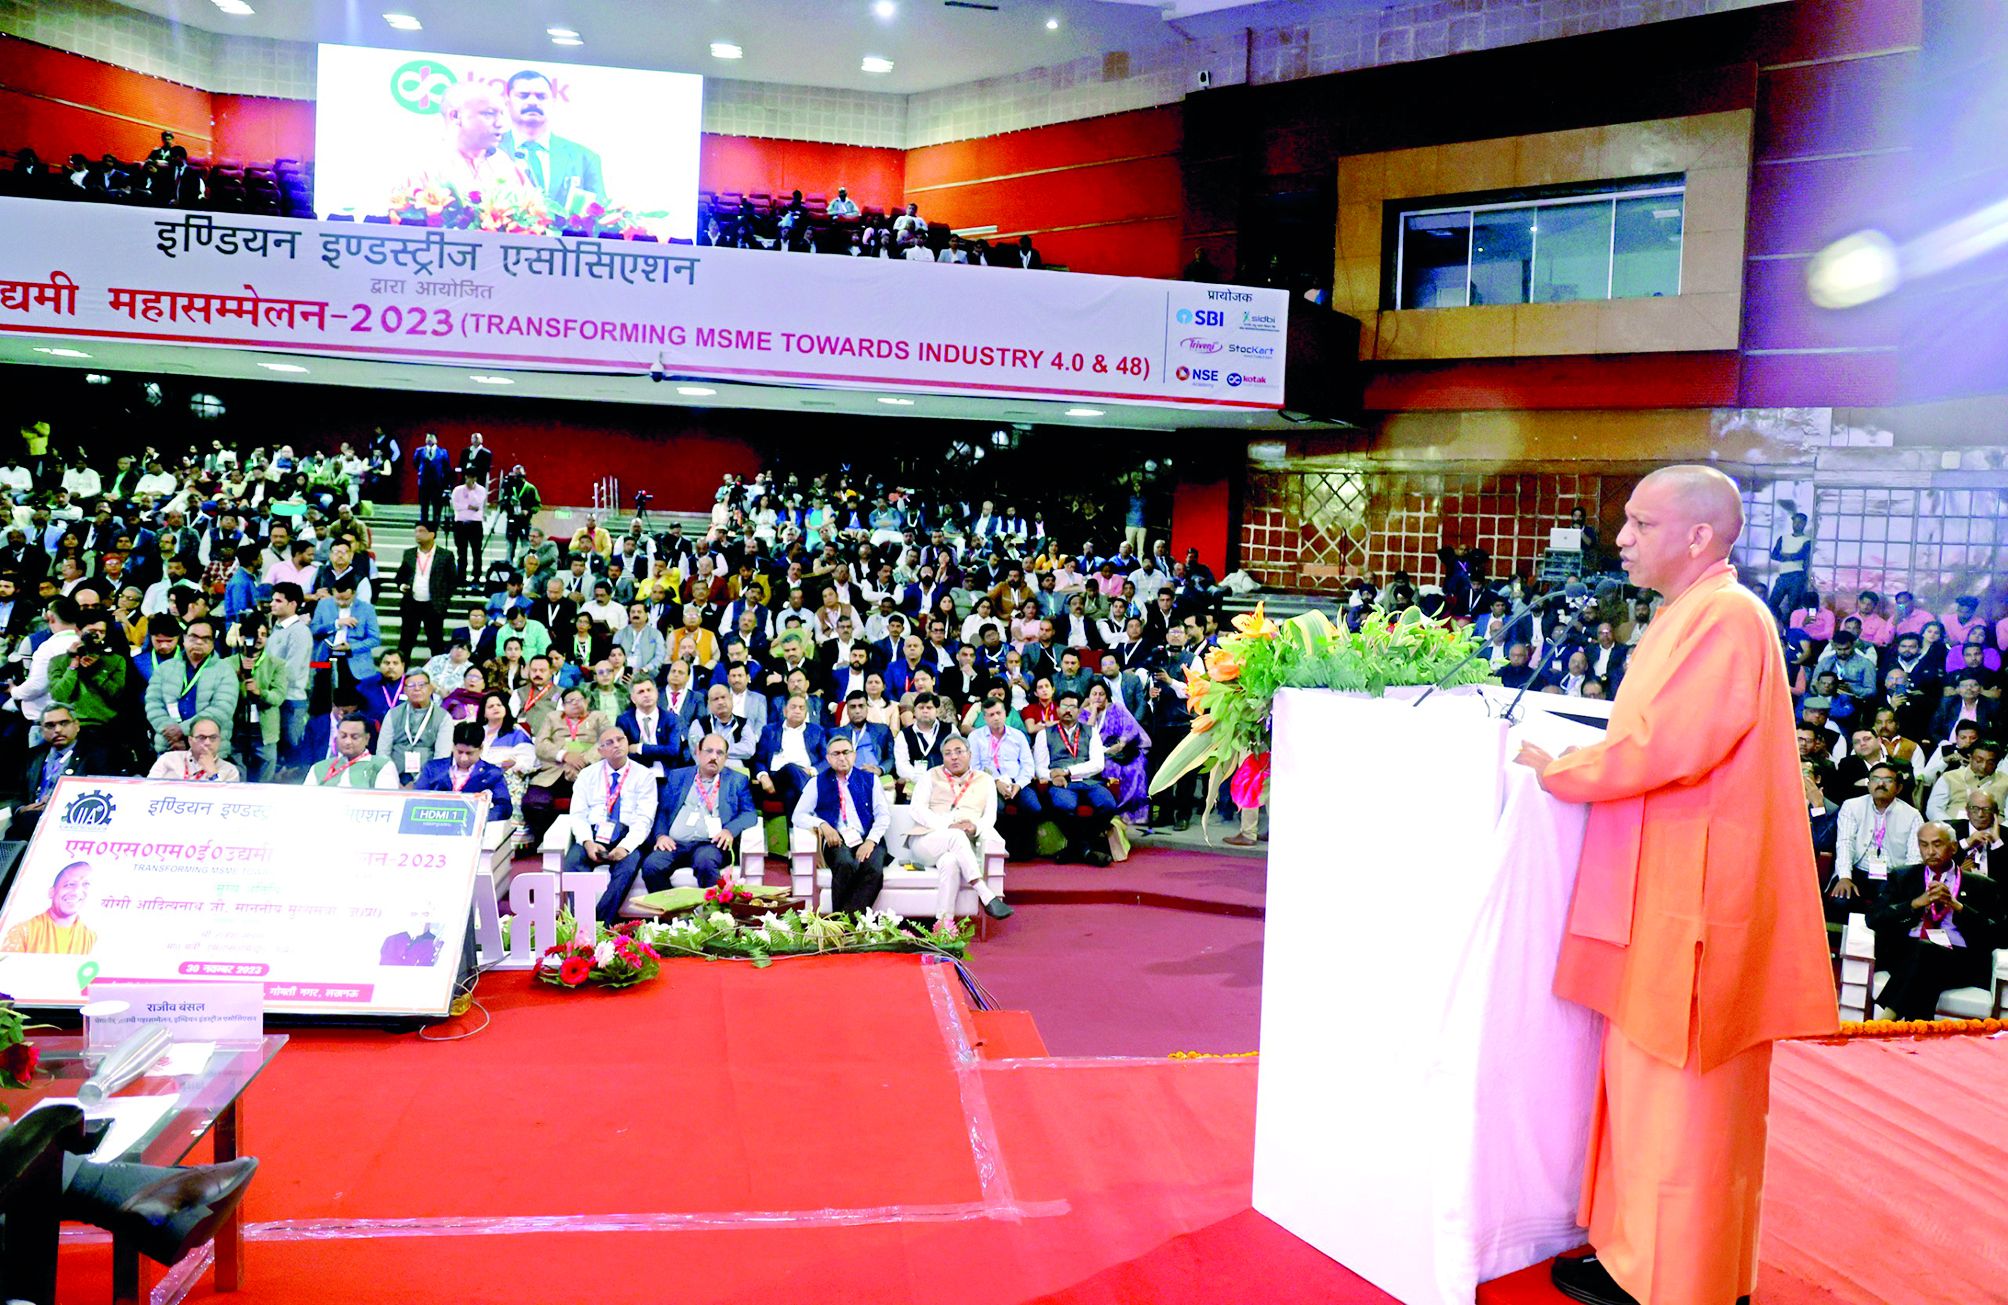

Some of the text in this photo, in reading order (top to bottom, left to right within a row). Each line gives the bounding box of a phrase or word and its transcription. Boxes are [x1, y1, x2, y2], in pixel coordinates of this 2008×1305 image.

[155, 214, 700, 285] इण्डियन इण्डस्ट्रीज एसोसिएशन
[370, 278, 495, 300] द्वारा आयोजित
[1208, 289, 1253, 303] प्रायोजक
[1195, 310, 1224, 327] SBI
[1251, 315, 1276, 323] sidbi
[461, 312, 686, 346] (TRANSFORMING
[695, 326, 772, 351] MSME
[781, 333, 910, 360] TOWARDS
[918, 342, 1044, 370] INDUSTRY
[1051, 352, 1084, 372] 4.0
[1092, 354, 1108, 374] &
[1116, 356, 1150, 381] 48)
[1193, 369, 1219, 381] NSE
[1243, 375, 1266, 384] kotak
[148, 796, 213, 816] इण्डियन
[420, 809, 458, 820] HDMI 1
[133, 863, 209, 874] TRANSFORMING
[101, 895, 131, 910] योगी
[136, 896, 204, 912] आदित्यनाथ
[186, 964, 200, 973] 30
[236, 965, 263, 975] 2023
[270, 985, 297, 997] गोमती
[147, 1001, 205, 1012] राजीव बंसल
